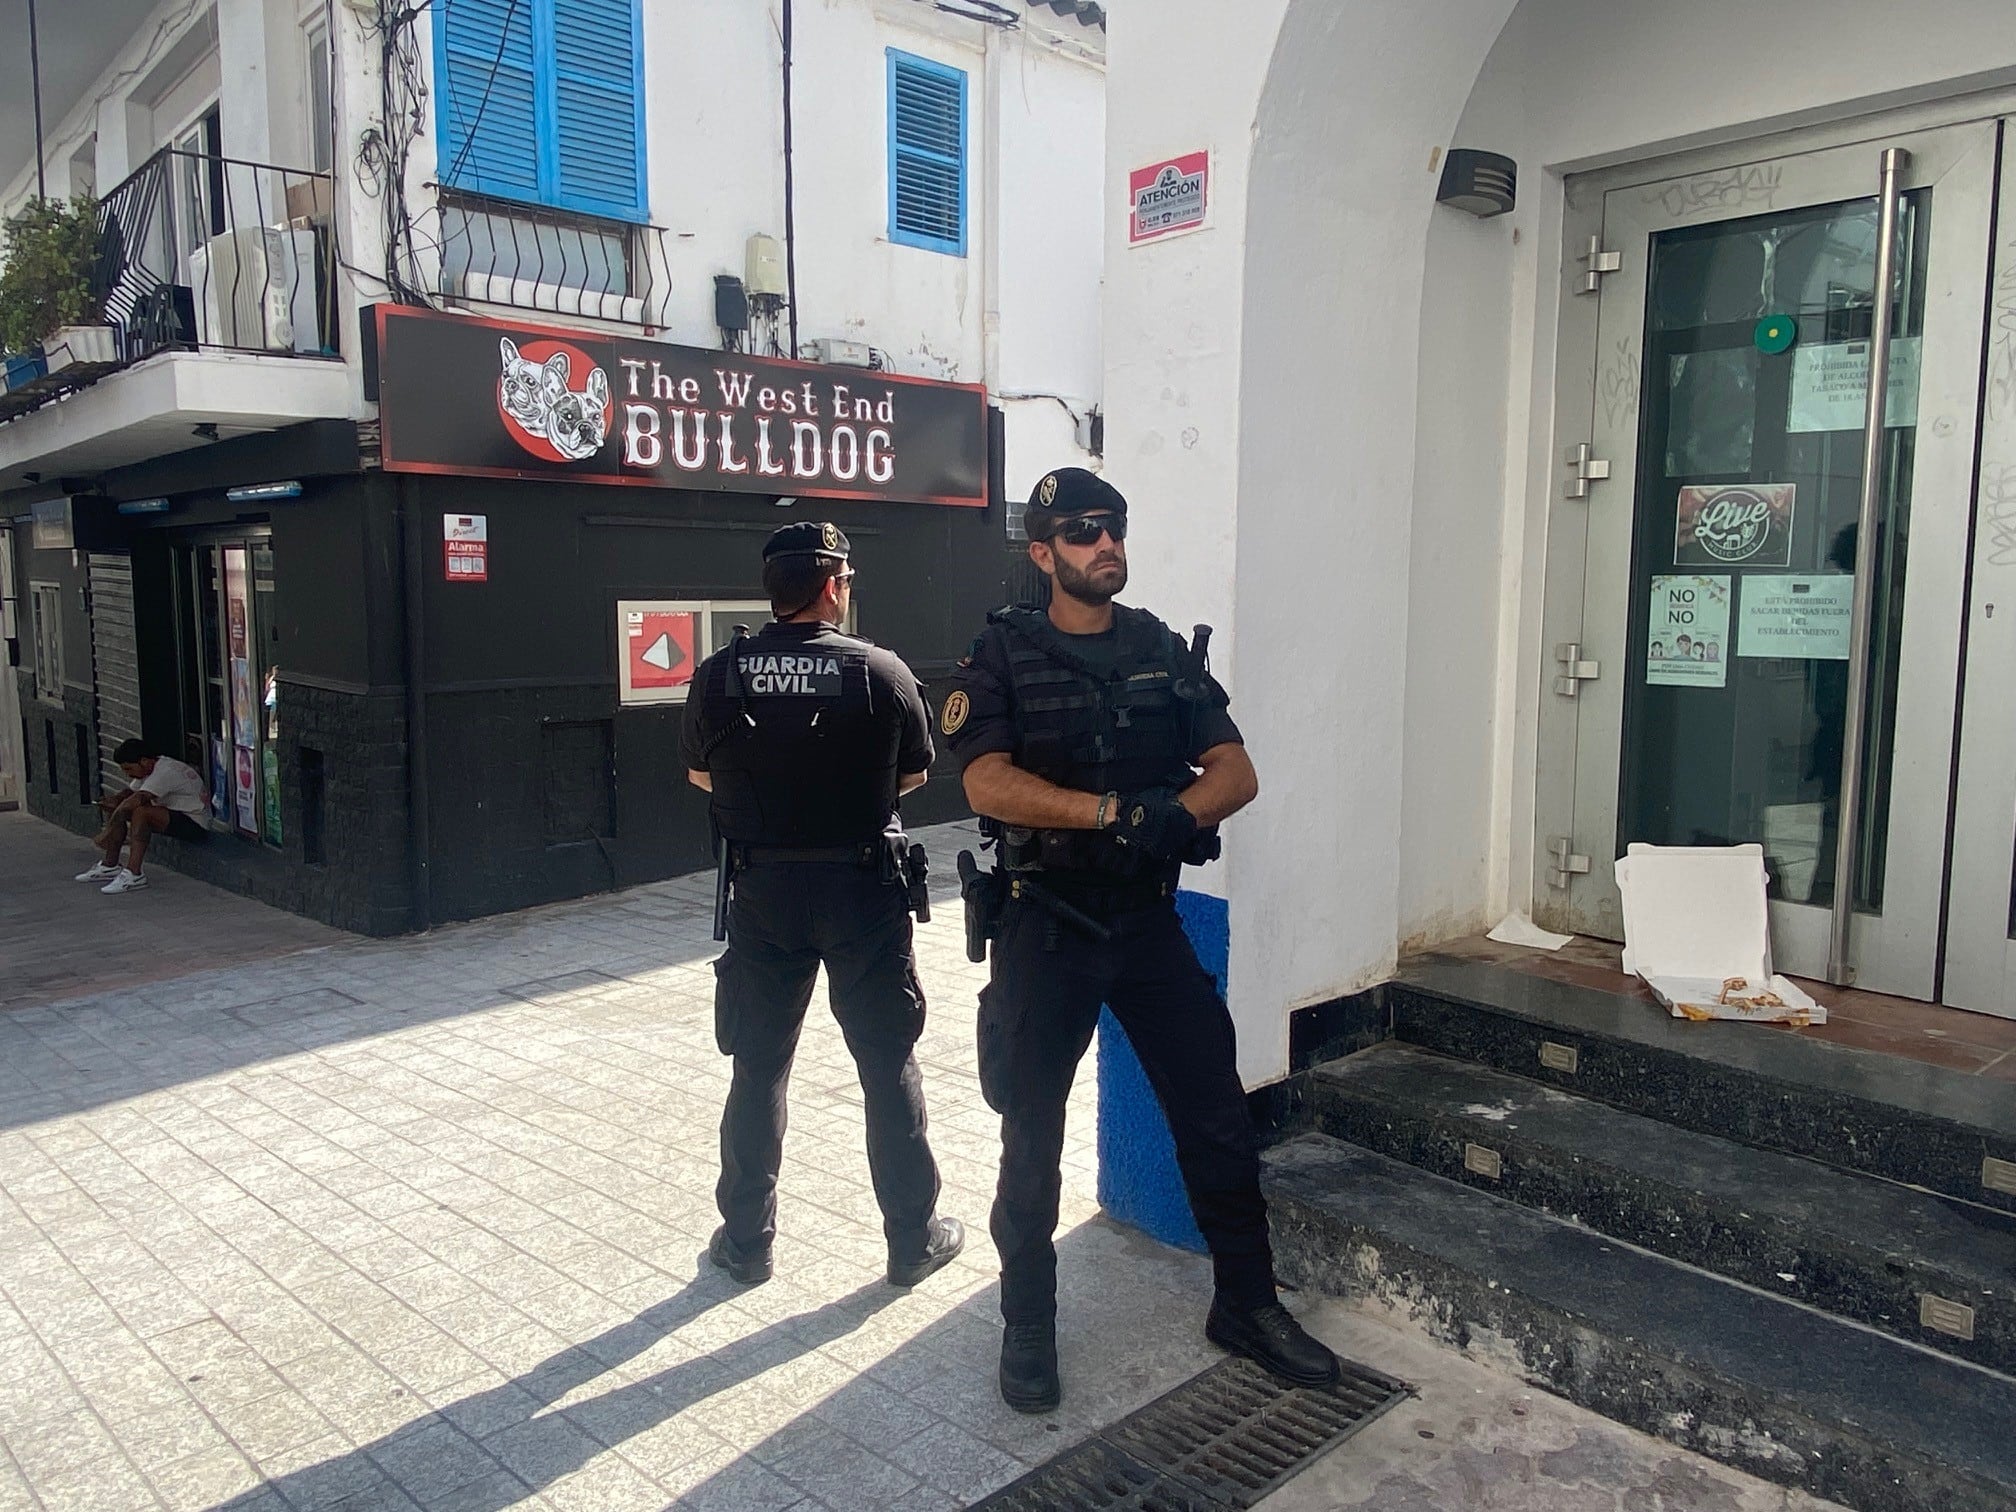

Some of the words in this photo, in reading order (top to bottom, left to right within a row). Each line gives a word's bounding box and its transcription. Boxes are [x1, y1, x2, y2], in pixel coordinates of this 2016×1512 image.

[1139, 179, 1200, 207] ATENCIÓN
[620, 358, 700, 403] The
[713, 369, 819, 417] West
[831, 383, 895, 424] End
[623, 402, 897, 484] BULLDOG
[1695, 501, 1771, 540] Live
[448, 541, 484, 552] Alarma
[1707, 541, 1732, 557] MUSIC
[1669, 589, 1695, 603] NO
[1668, 610, 1694, 624] NO
[1751, 608, 1779, 616] SACAR
[1821, 608, 1851, 616] FUERA
[1757, 628, 1840, 636] ESTABLECIMIENTO
[752, 675, 817, 693] CIVIL
